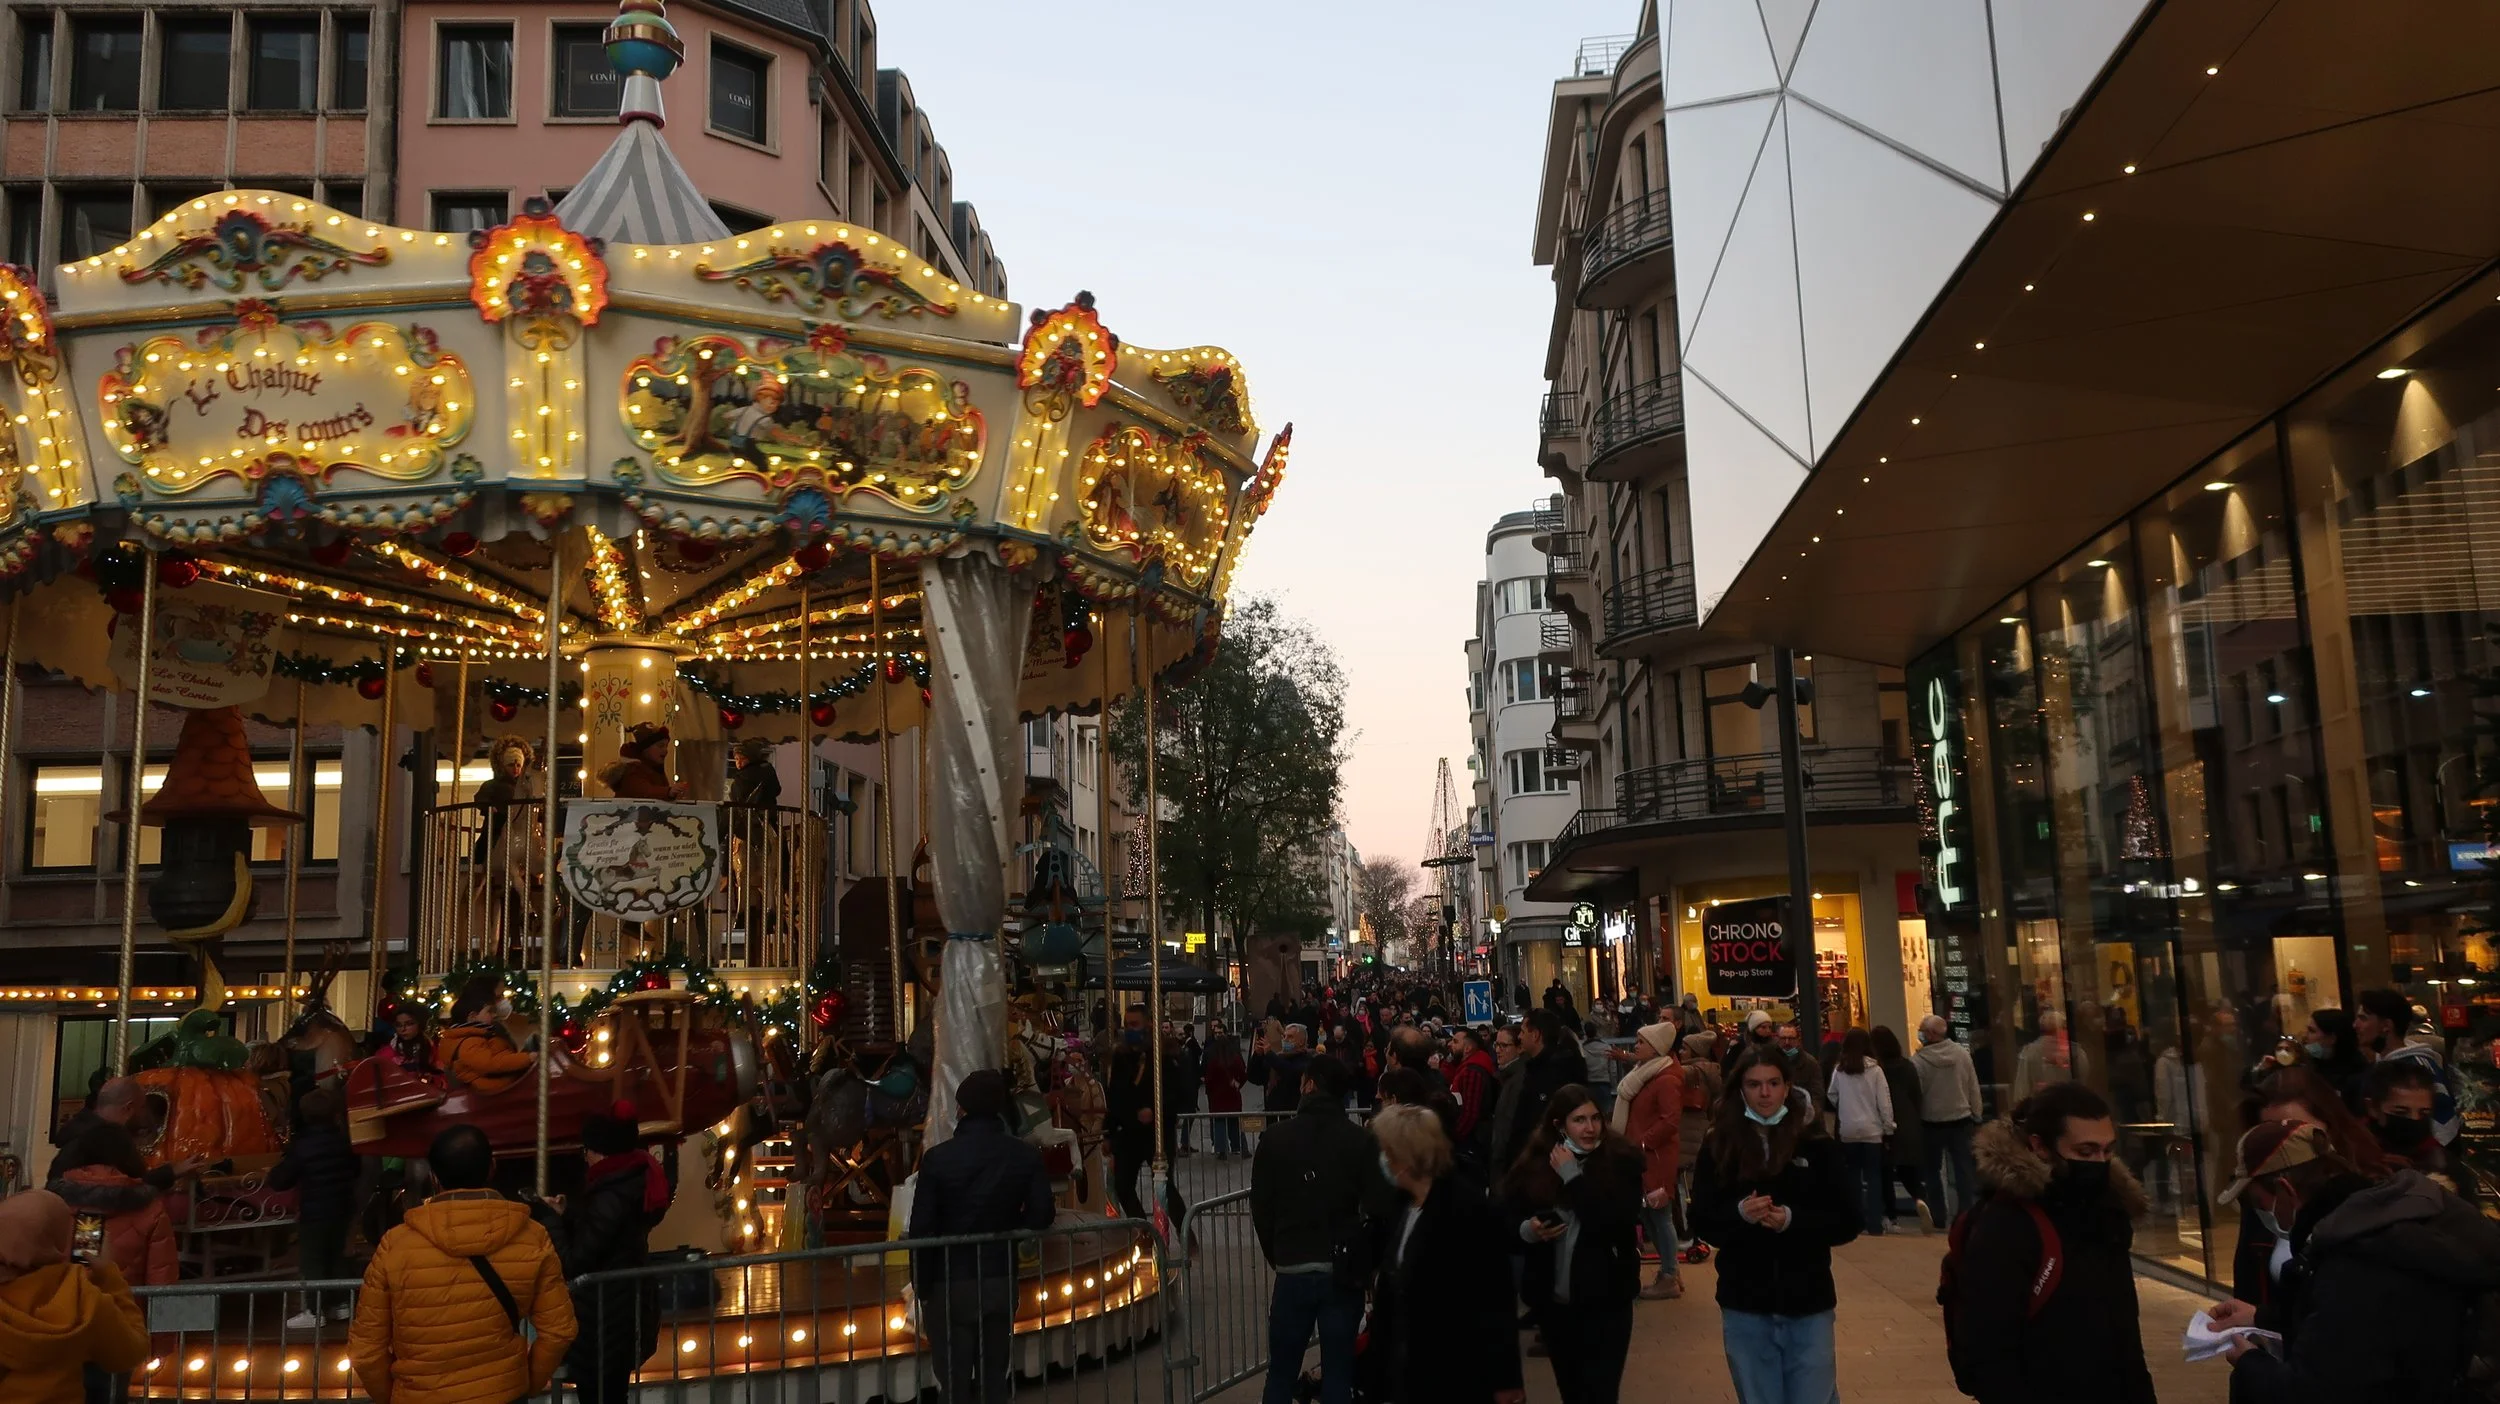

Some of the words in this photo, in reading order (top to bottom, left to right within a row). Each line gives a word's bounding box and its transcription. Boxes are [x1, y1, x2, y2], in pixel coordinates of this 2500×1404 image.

[185, 378, 220, 416] Le
[226, 361, 324, 398] Chahut
[237, 405, 290, 439] Des
[151, 667, 175, 679] Le
[177, 672, 225, 689] Chahut
[176, 687, 220, 702] Contes
[1928, 677, 1961, 911] fnac
[1470, 834, 1494, 842] Berlitz
[1709, 922, 1782, 940] CHRONO
[1710, 941, 1784, 963] STOCK
[1719, 969, 1749, 979] Pop-up
[1751, 968, 1773, 976] Store
